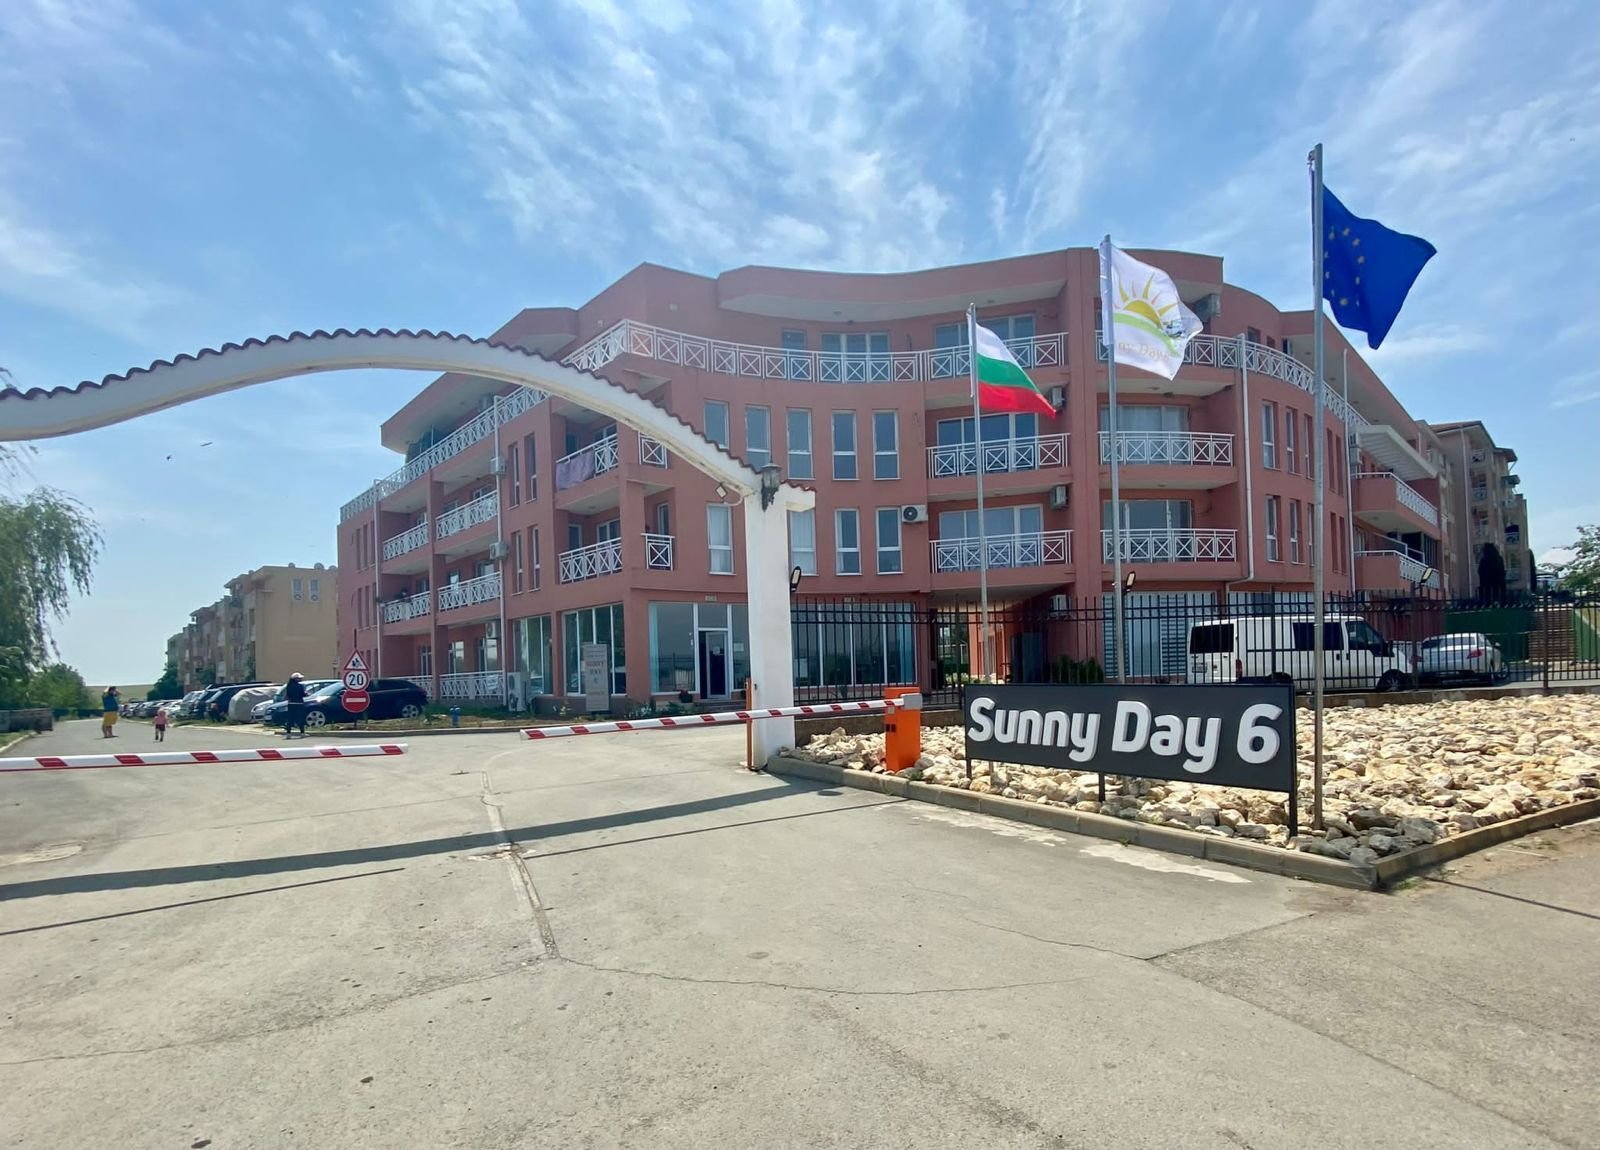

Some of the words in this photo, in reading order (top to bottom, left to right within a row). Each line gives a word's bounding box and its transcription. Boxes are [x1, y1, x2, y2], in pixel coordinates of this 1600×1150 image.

[349, 673, 364, 686] 20
[967, 697, 1101, 763] Sunny
[1111, 700, 1222, 774] Day
[1236, 703, 1283, 764] 6
